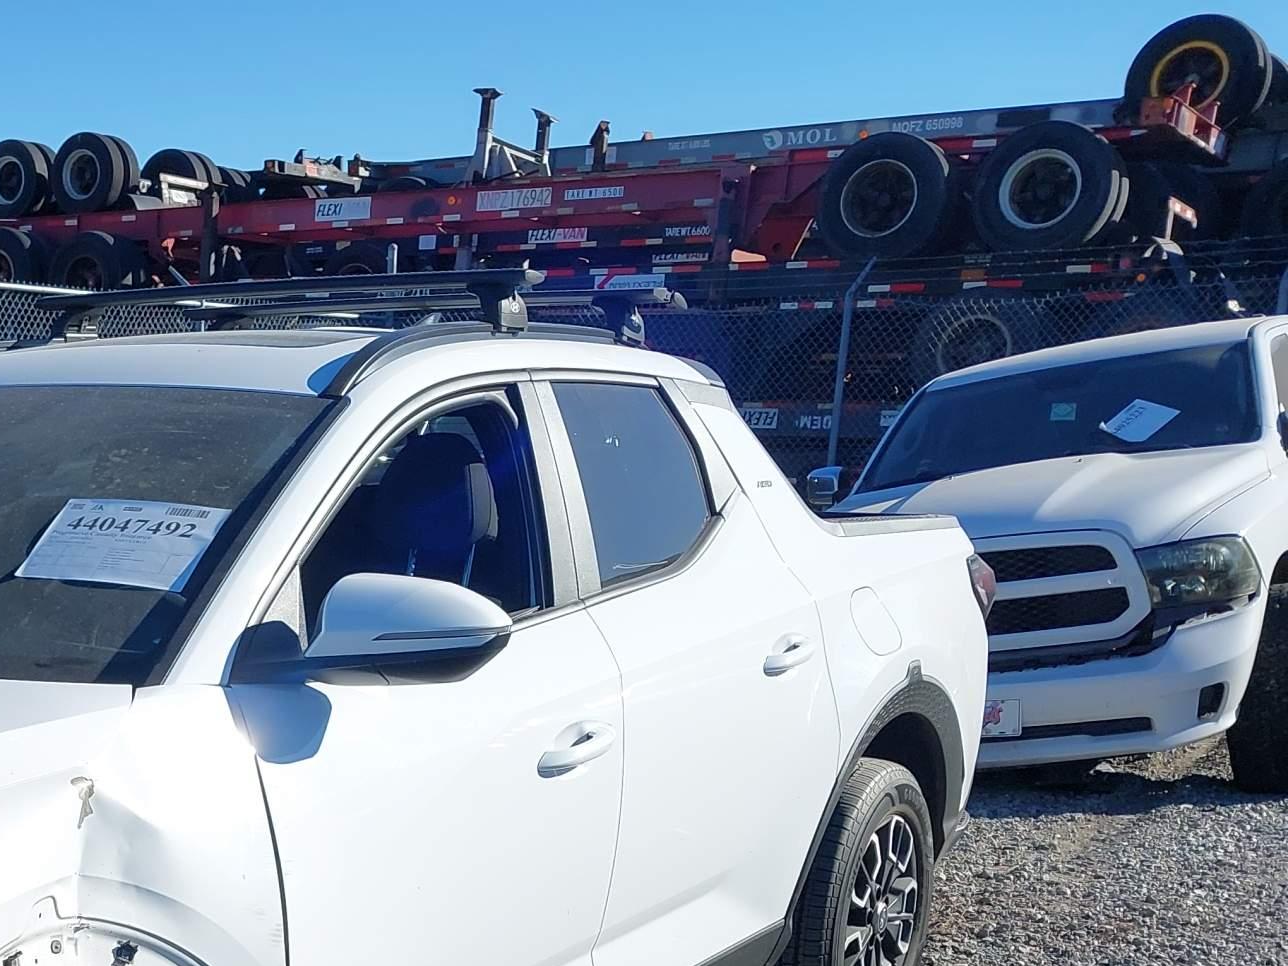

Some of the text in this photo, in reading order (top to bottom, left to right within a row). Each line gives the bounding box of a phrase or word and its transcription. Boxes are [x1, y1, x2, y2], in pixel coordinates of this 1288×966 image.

[925, 116, 963, 131] 650998
[787, 129, 837, 146] MOL
[316, 203, 343, 217] FLEXI
[67, 515, 197, 539] 44047492
